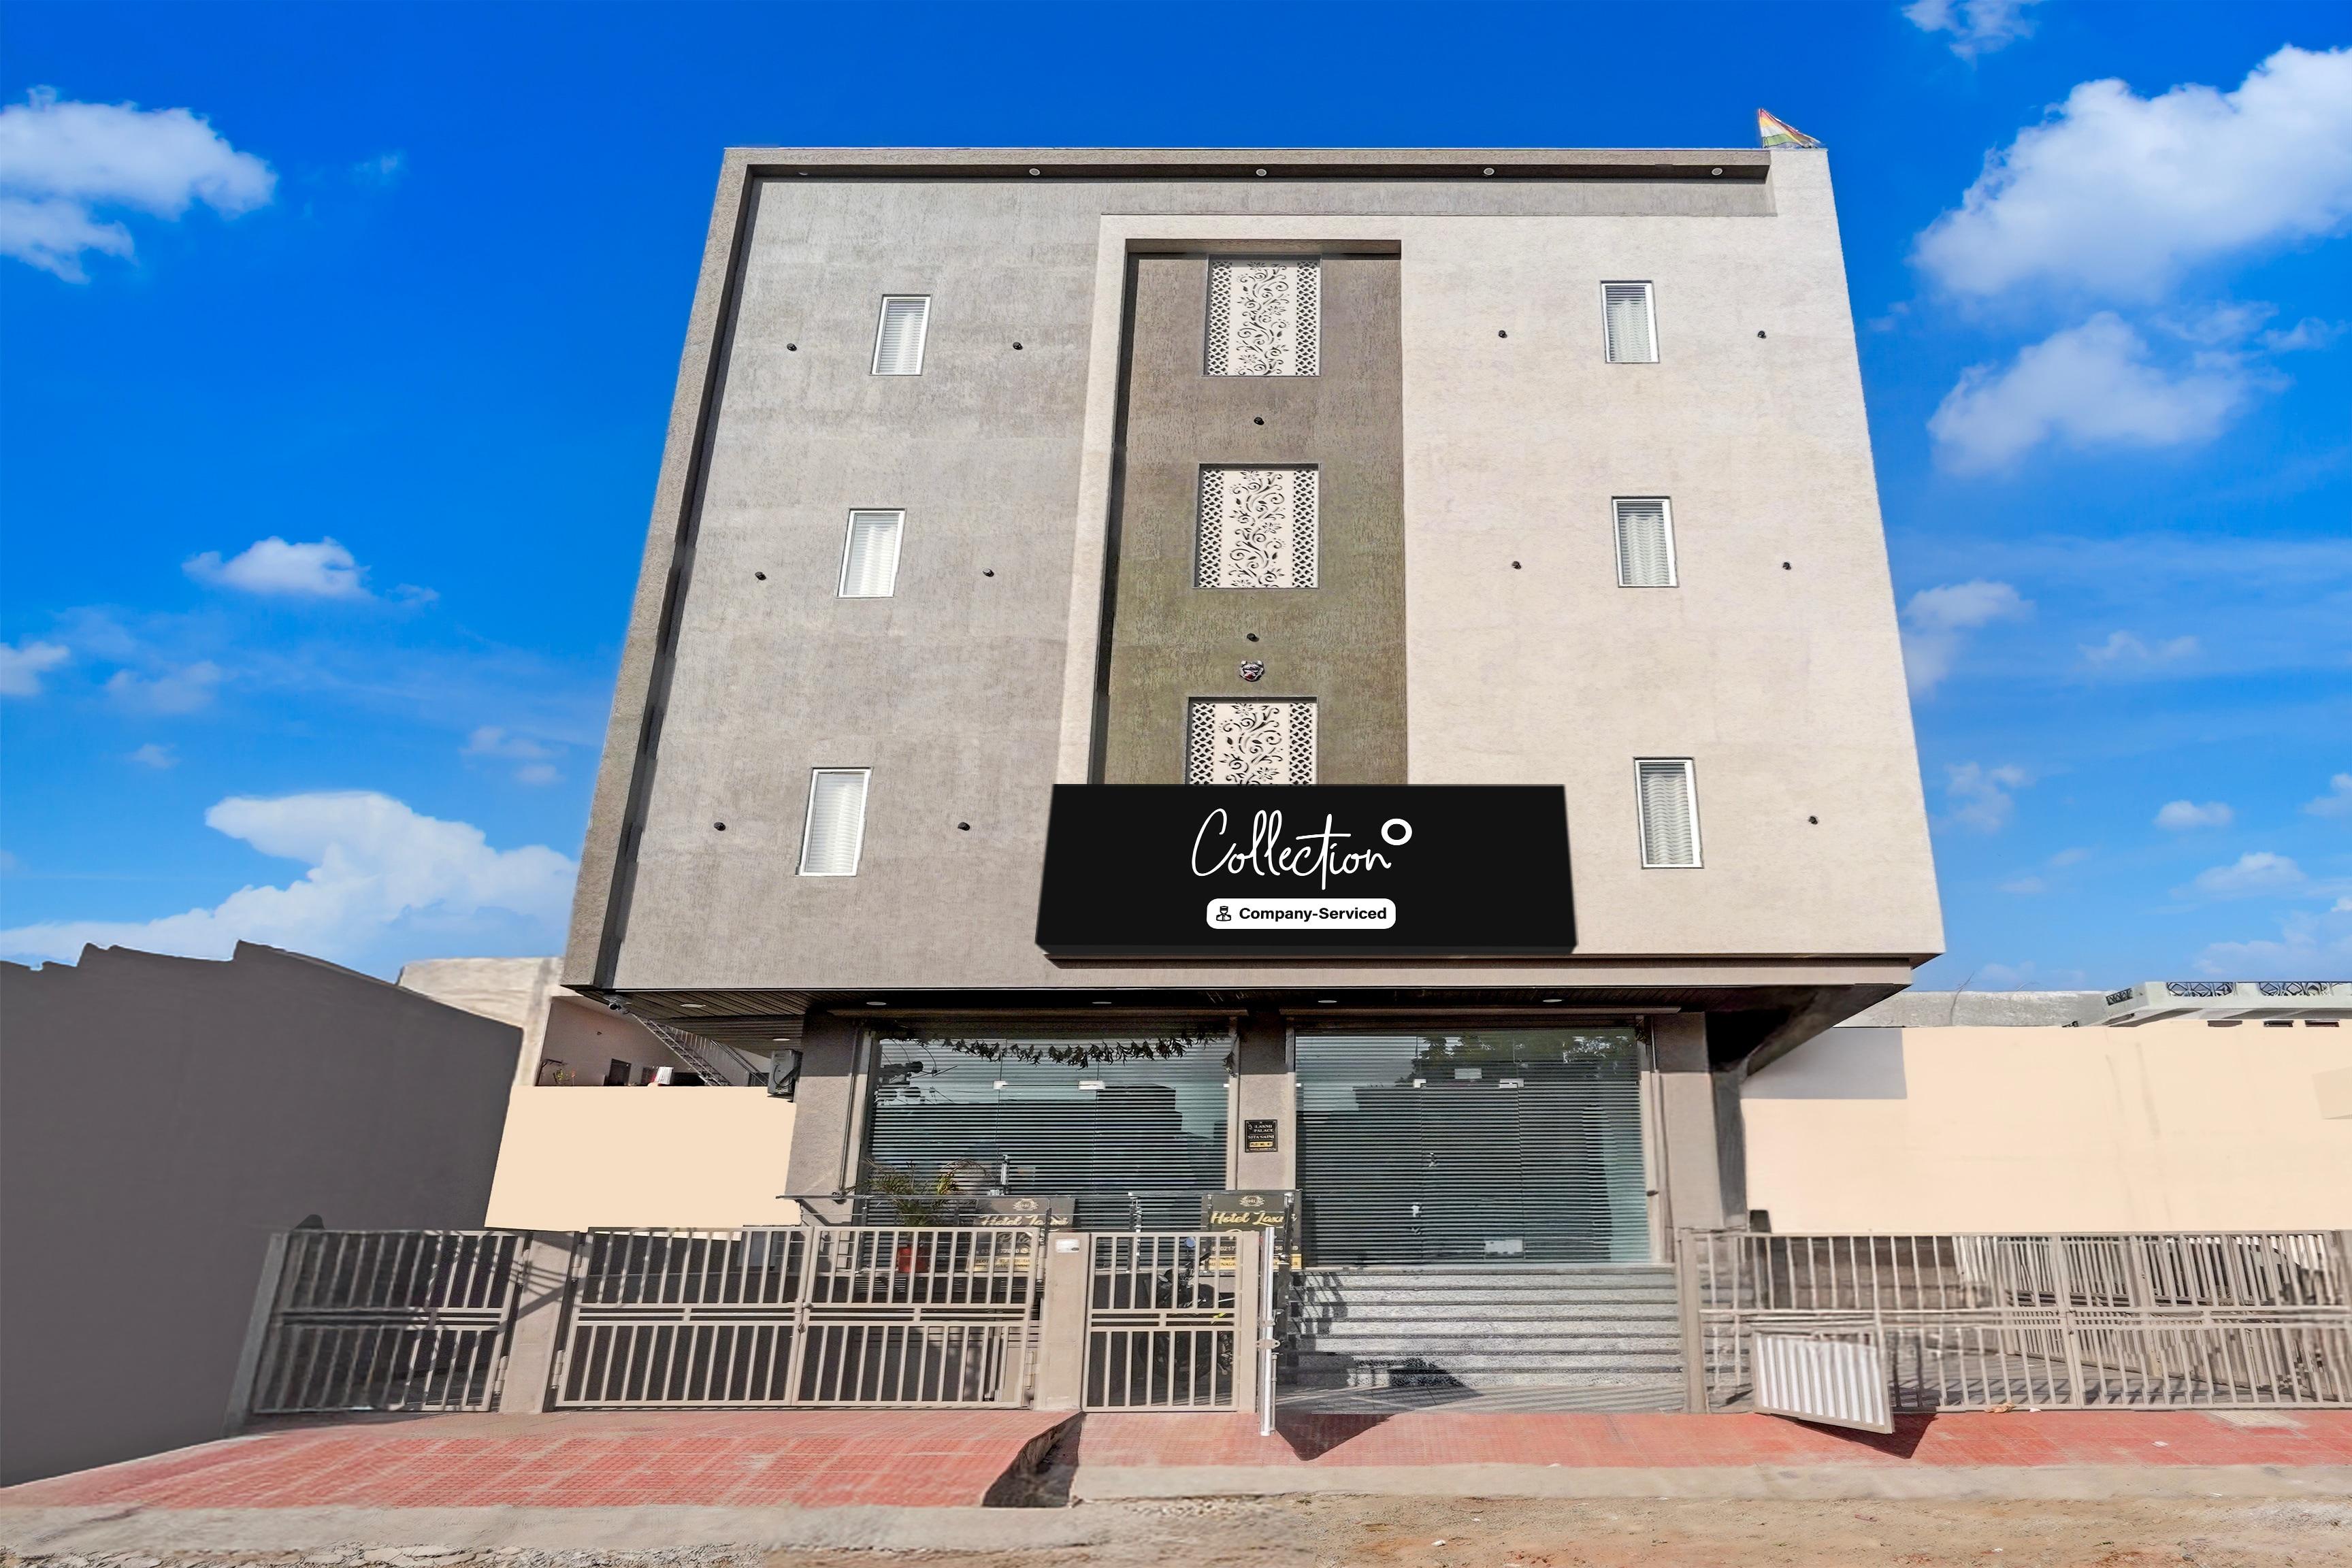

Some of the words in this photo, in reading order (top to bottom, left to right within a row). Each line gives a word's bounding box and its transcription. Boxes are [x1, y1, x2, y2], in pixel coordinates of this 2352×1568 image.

[1191, 808, 1392, 891] Collection
[1239, 907, 1387, 922] Company-Serviced
[979, 1214, 1023, 1226] Hotel
[1210, 1211, 1251, 1224] Hotel
